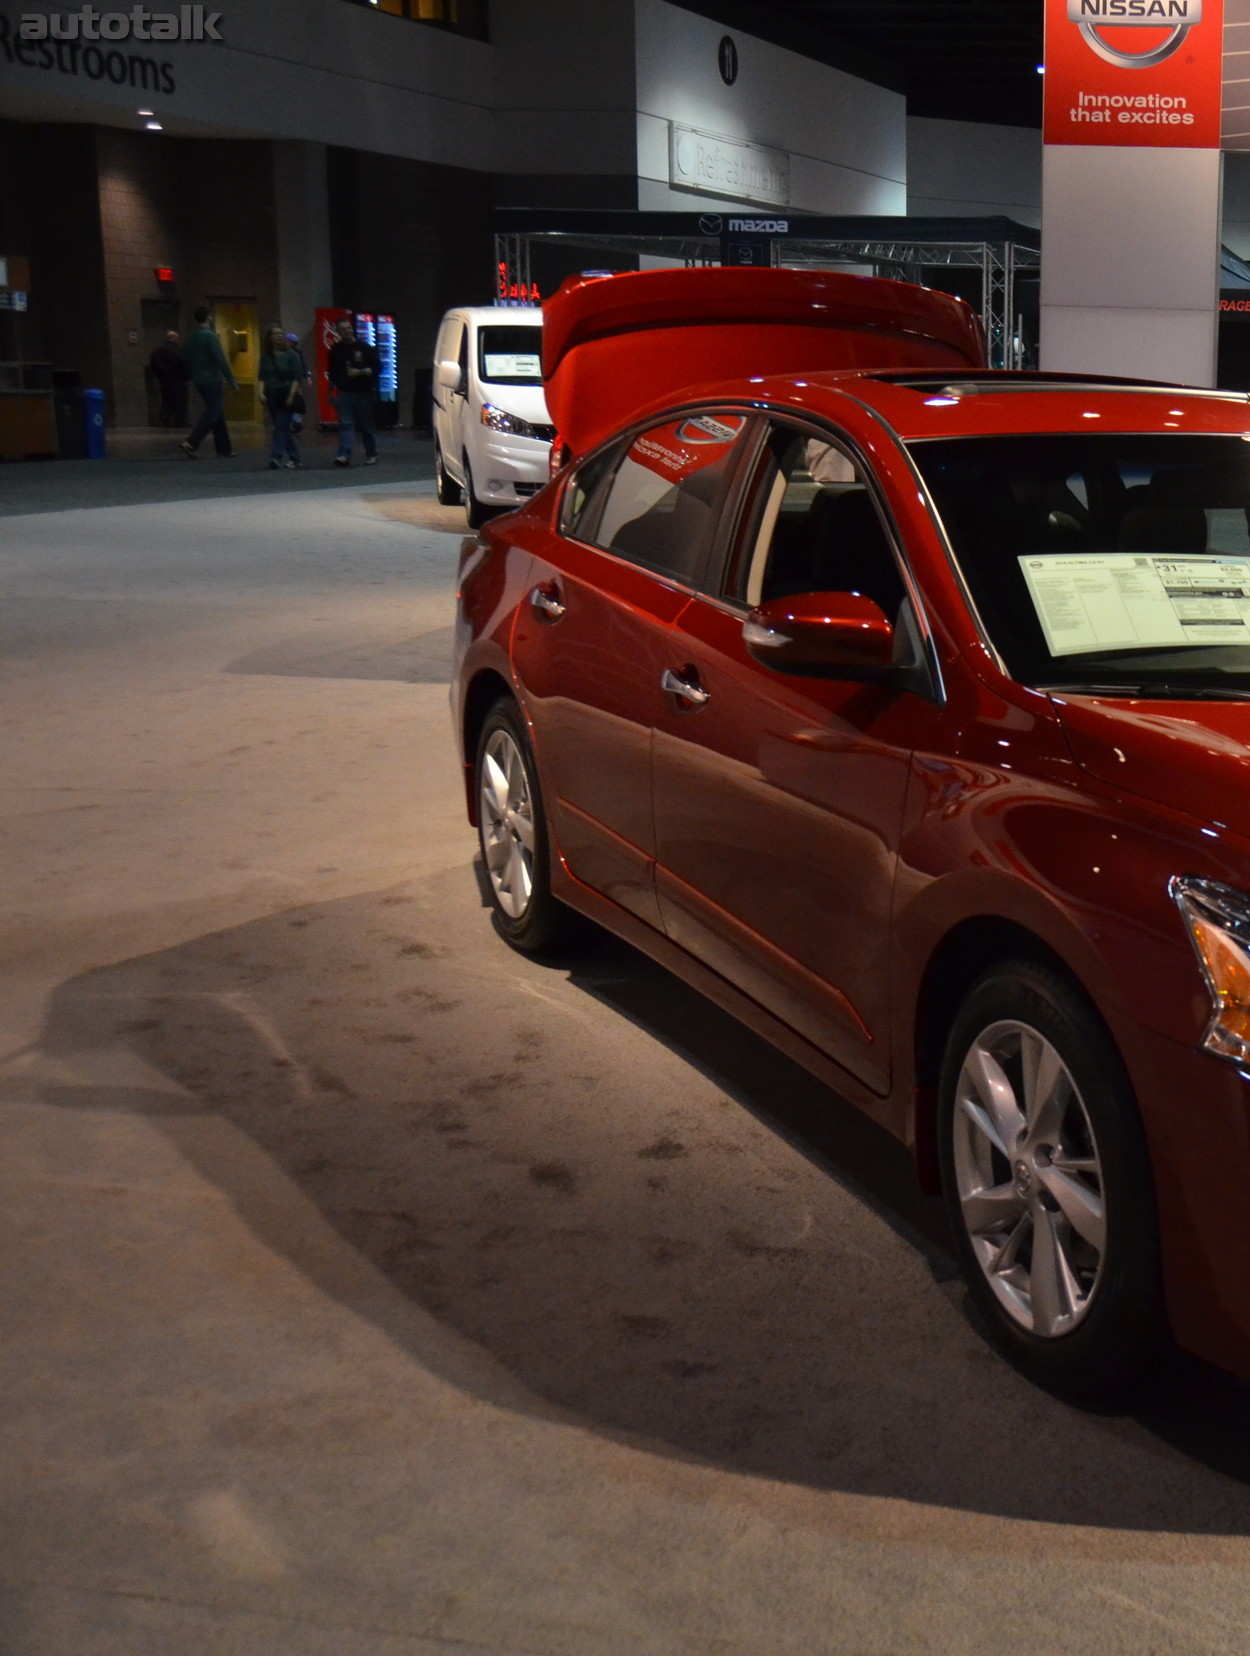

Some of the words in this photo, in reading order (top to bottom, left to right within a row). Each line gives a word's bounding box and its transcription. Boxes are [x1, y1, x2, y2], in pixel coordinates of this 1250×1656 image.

[1081, 0, 1188, 17] NISSAN
[1078, 91, 1187, 109] Innovation
[1070, 108, 1112, 122] that
[1117, 110, 1195, 125] excites
[728, 218, 789, 233] mazda
